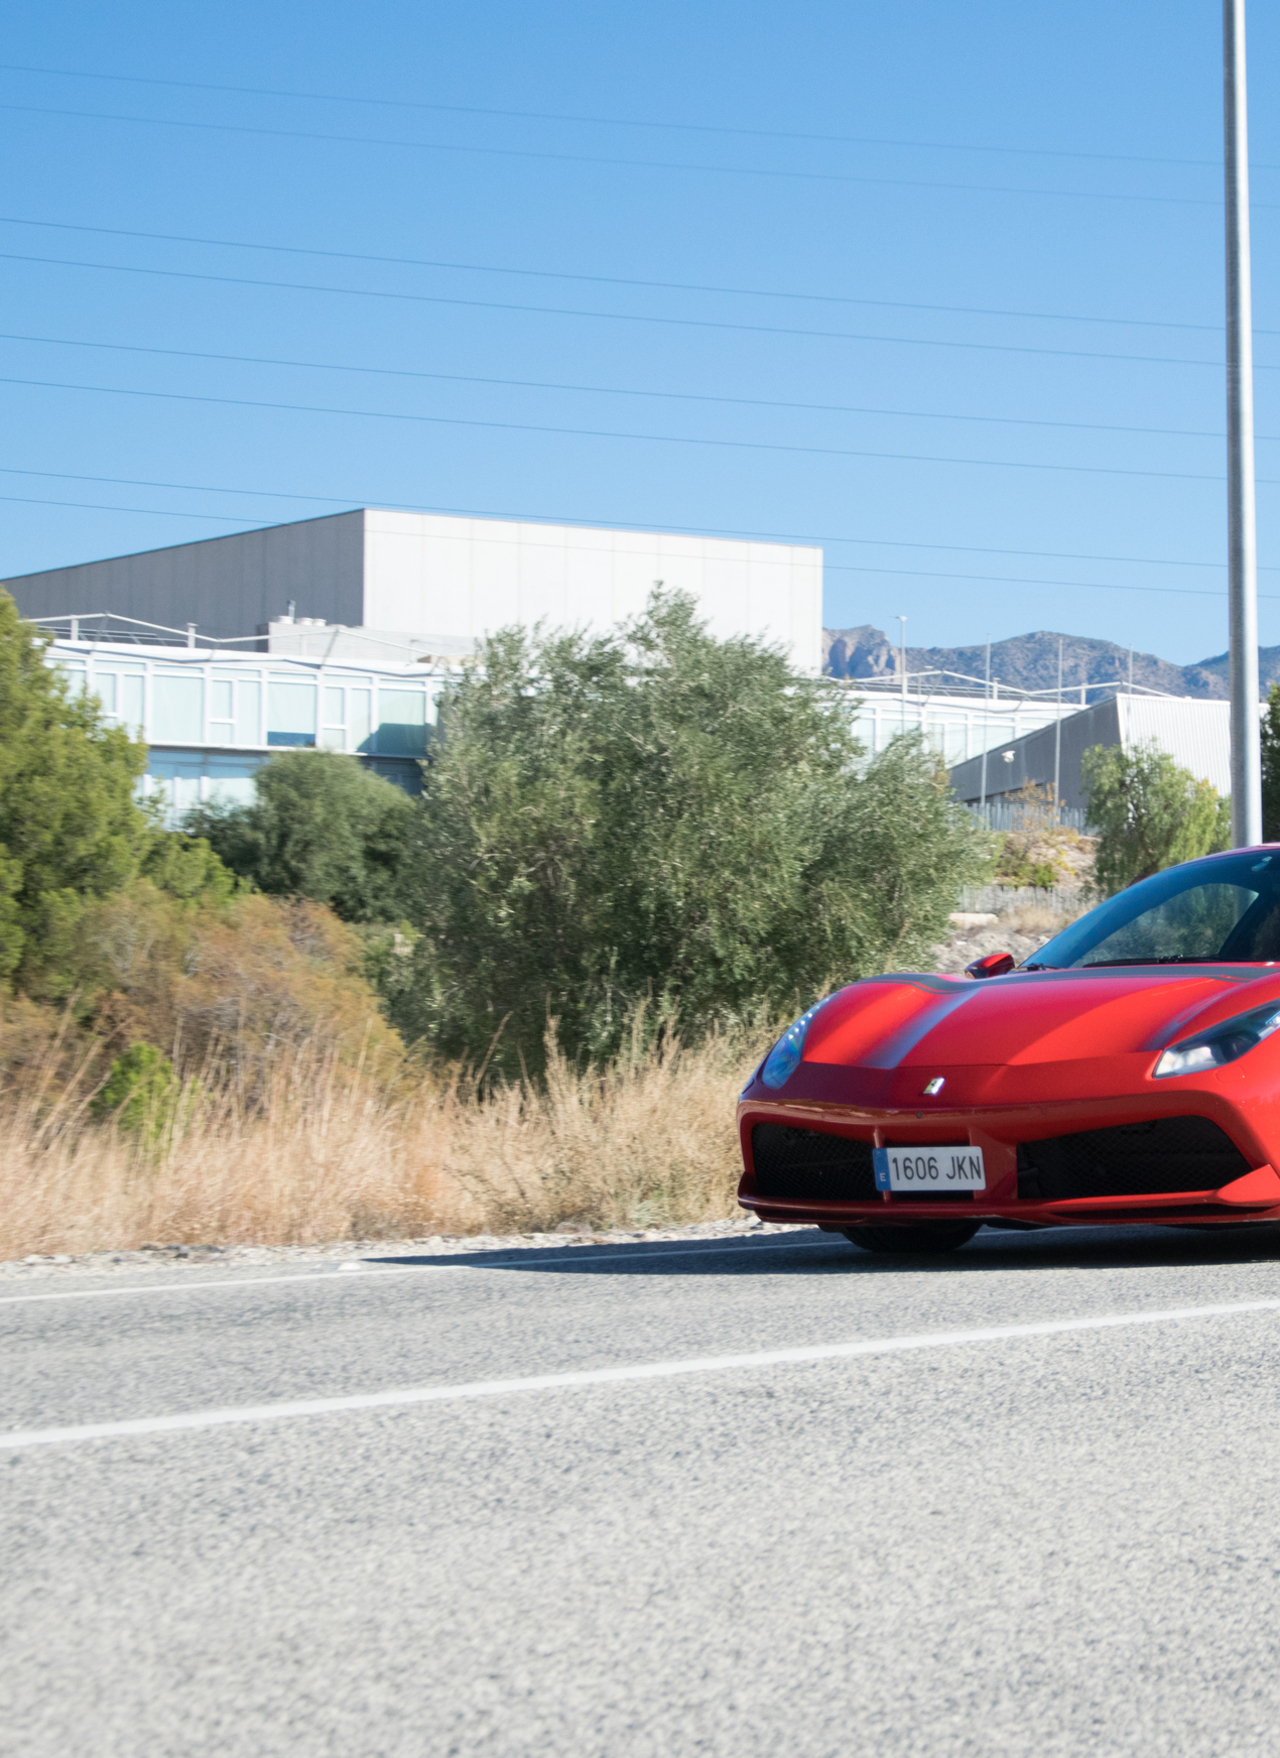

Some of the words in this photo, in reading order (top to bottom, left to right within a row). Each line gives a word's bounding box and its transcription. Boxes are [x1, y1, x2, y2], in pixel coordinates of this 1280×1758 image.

[879, 1172, 887, 1182] E
[892, 1157, 939, 1181] 1606
[946, 1156, 982, 1180] JKN
